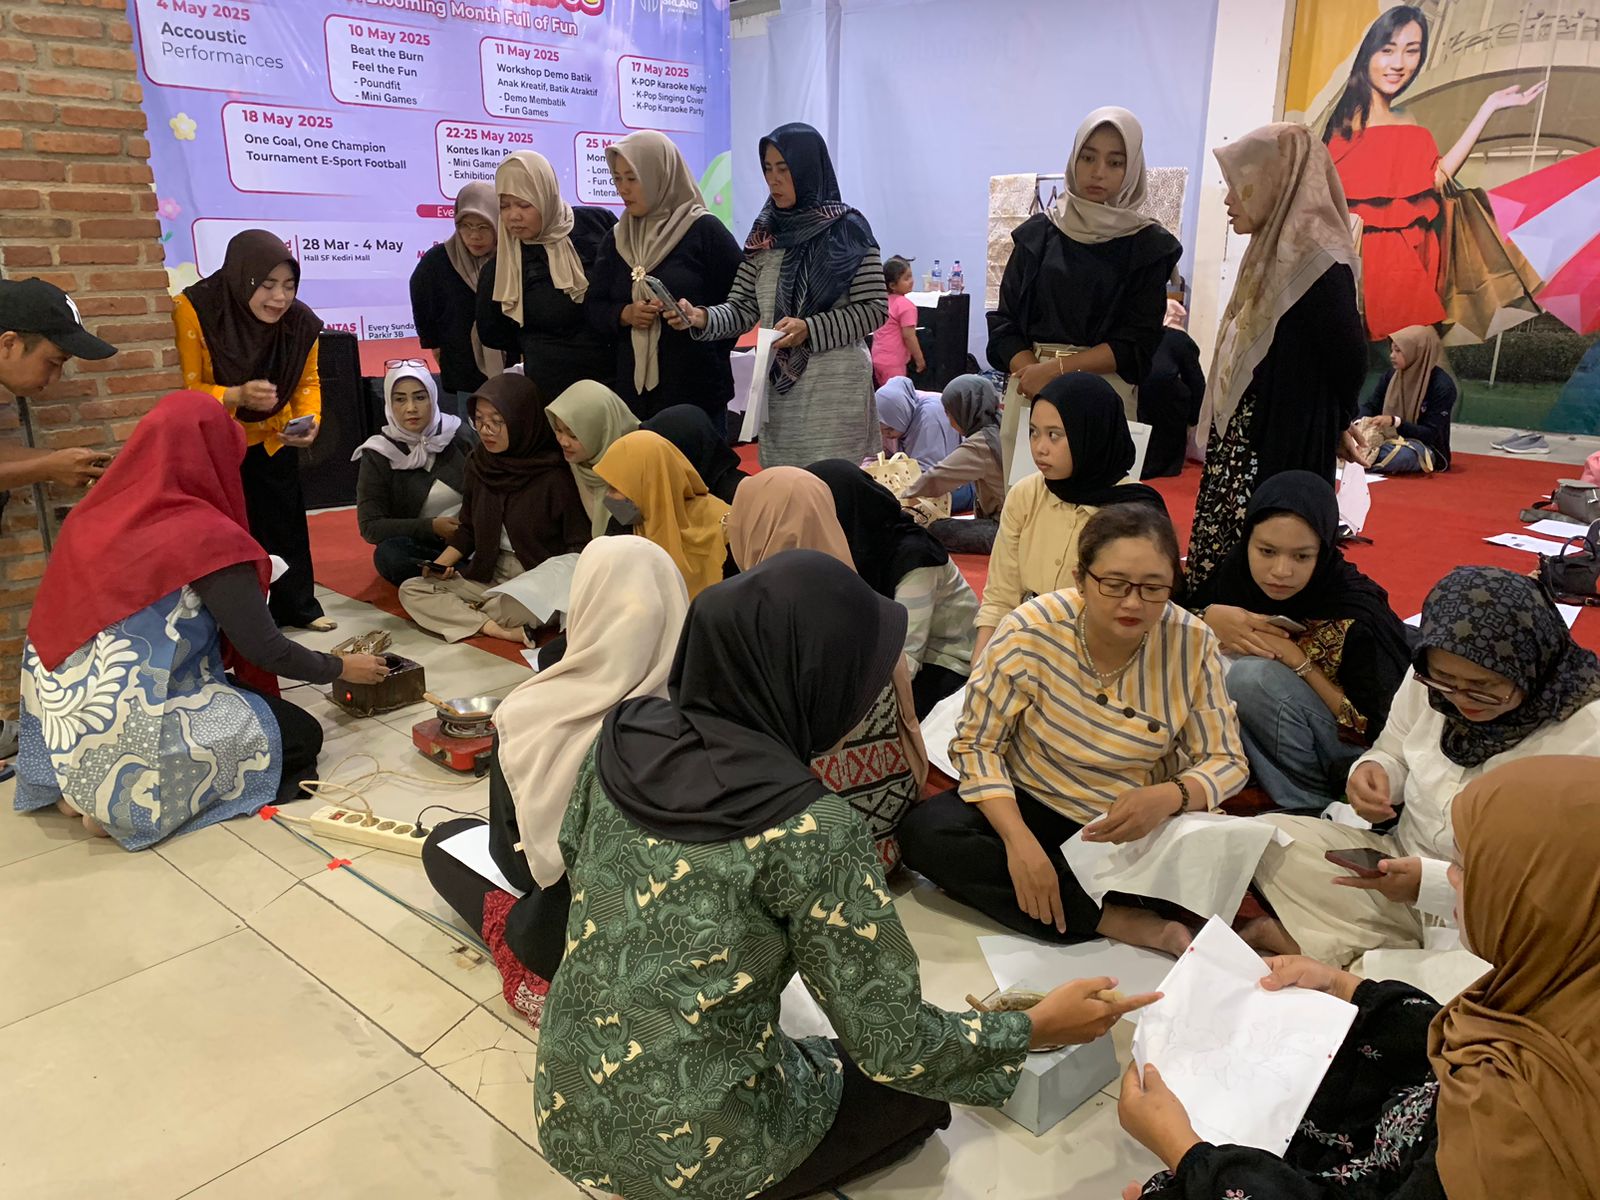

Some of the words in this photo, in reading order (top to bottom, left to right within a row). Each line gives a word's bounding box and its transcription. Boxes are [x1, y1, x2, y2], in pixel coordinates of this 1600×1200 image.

[172, 0, 207, 18] May
[212, 4, 250, 21] 2025
[451, 2, 500, 22] Month
[504, 10, 531, 27] Full
[535, 15, 549, 30] of
[552, 19, 578, 34] Fun
[161, 22, 247, 45] Accoustic
[348, 24, 364, 37] 10
[368, 27, 396, 44] May
[399, 31, 431, 46] 2025
[162, 42, 284, 69] Performances
[351, 44, 375, 56] Beat
[378, 48, 396, 59] the
[399, 50, 424, 62] Burn
[495, 43, 504, 55] 11
[508, 45, 531, 60] May
[534, 49, 560, 62] 2025
[352, 61, 375, 73] Feel
[377, 64, 396, 75] the
[398, 66, 418, 77] Fun
[497, 63, 542, 78] Workshop
[544, 69, 569, 80] Demo
[571, 73, 592, 83] Batik
[631, 62, 641, 72] 17
[644, 64, 663, 77] May
[665, 67, 689, 78] 2025
[360, 77, 401, 91] Poundfit
[497, 78, 519, 88] Anak
[521, 81, 549, 92] Kreatif,
[549, 84, 569, 94] Batik
[570, 87, 598, 97] Atraktif
[631, 78, 656, 87] K-POP
[657, 80, 689, 91] Karaoke
[690, 84, 707, 95] Night
[361, 91, 382, 102] Mini
[384, 93, 418, 105] Games
[504, 92, 528, 103] Demo
[529, 95, 567, 107] Membatik
[636, 90, 657, 101] K-Pop
[658, 93, 685, 104] Singing
[686, 95, 704, 105] Cover
[505, 105, 520, 114] Fun
[522, 106, 549, 117] Games
[637, 102, 657, 112] K-Pop
[658, 104, 688, 114] Karaoke
[689, 106, 704, 117] Party
[242, 109, 259, 123] 18
[263, 112, 293, 129] May
[298, 115, 334, 129] 2025
[445, 127, 478, 140] 22-25
[481, 130, 505, 144] May
[507, 132, 534, 144] 2025
[586, 138, 599, 148] 25
[244, 134, 270, 145] One
[272, 136, 301, 148] Goal,
[304, 138, 329, 149] One
[331, 140, 386, 154] Champion
[446, 145, 479, 155] Kontes
[481, 147, 501, 156] Ikan
[246, 151, 318, 165] Tournament
[322, 156, 362, 168] E-Sport
[365, 158, 407, 170] Football
[453, 158, 471, 168] Mini
[454, 170, 495, 181] Exhibition
[593, 177, 607, 186] Fun
[302, 239, 320, 250] 28
[324, 239, 350, 250] Mar
[363, 239, 373, 250] 4
[376, 240, 404, 253] May
[304, 254, 320, 262] Hall
[321, 254, 330, 262] SF
[332, 254, 354, 262] Kediri
[355, 254, 371, 262] Mall
[368, 324, 389, 333] Every
[369, 331, 393, 339] Parkir
